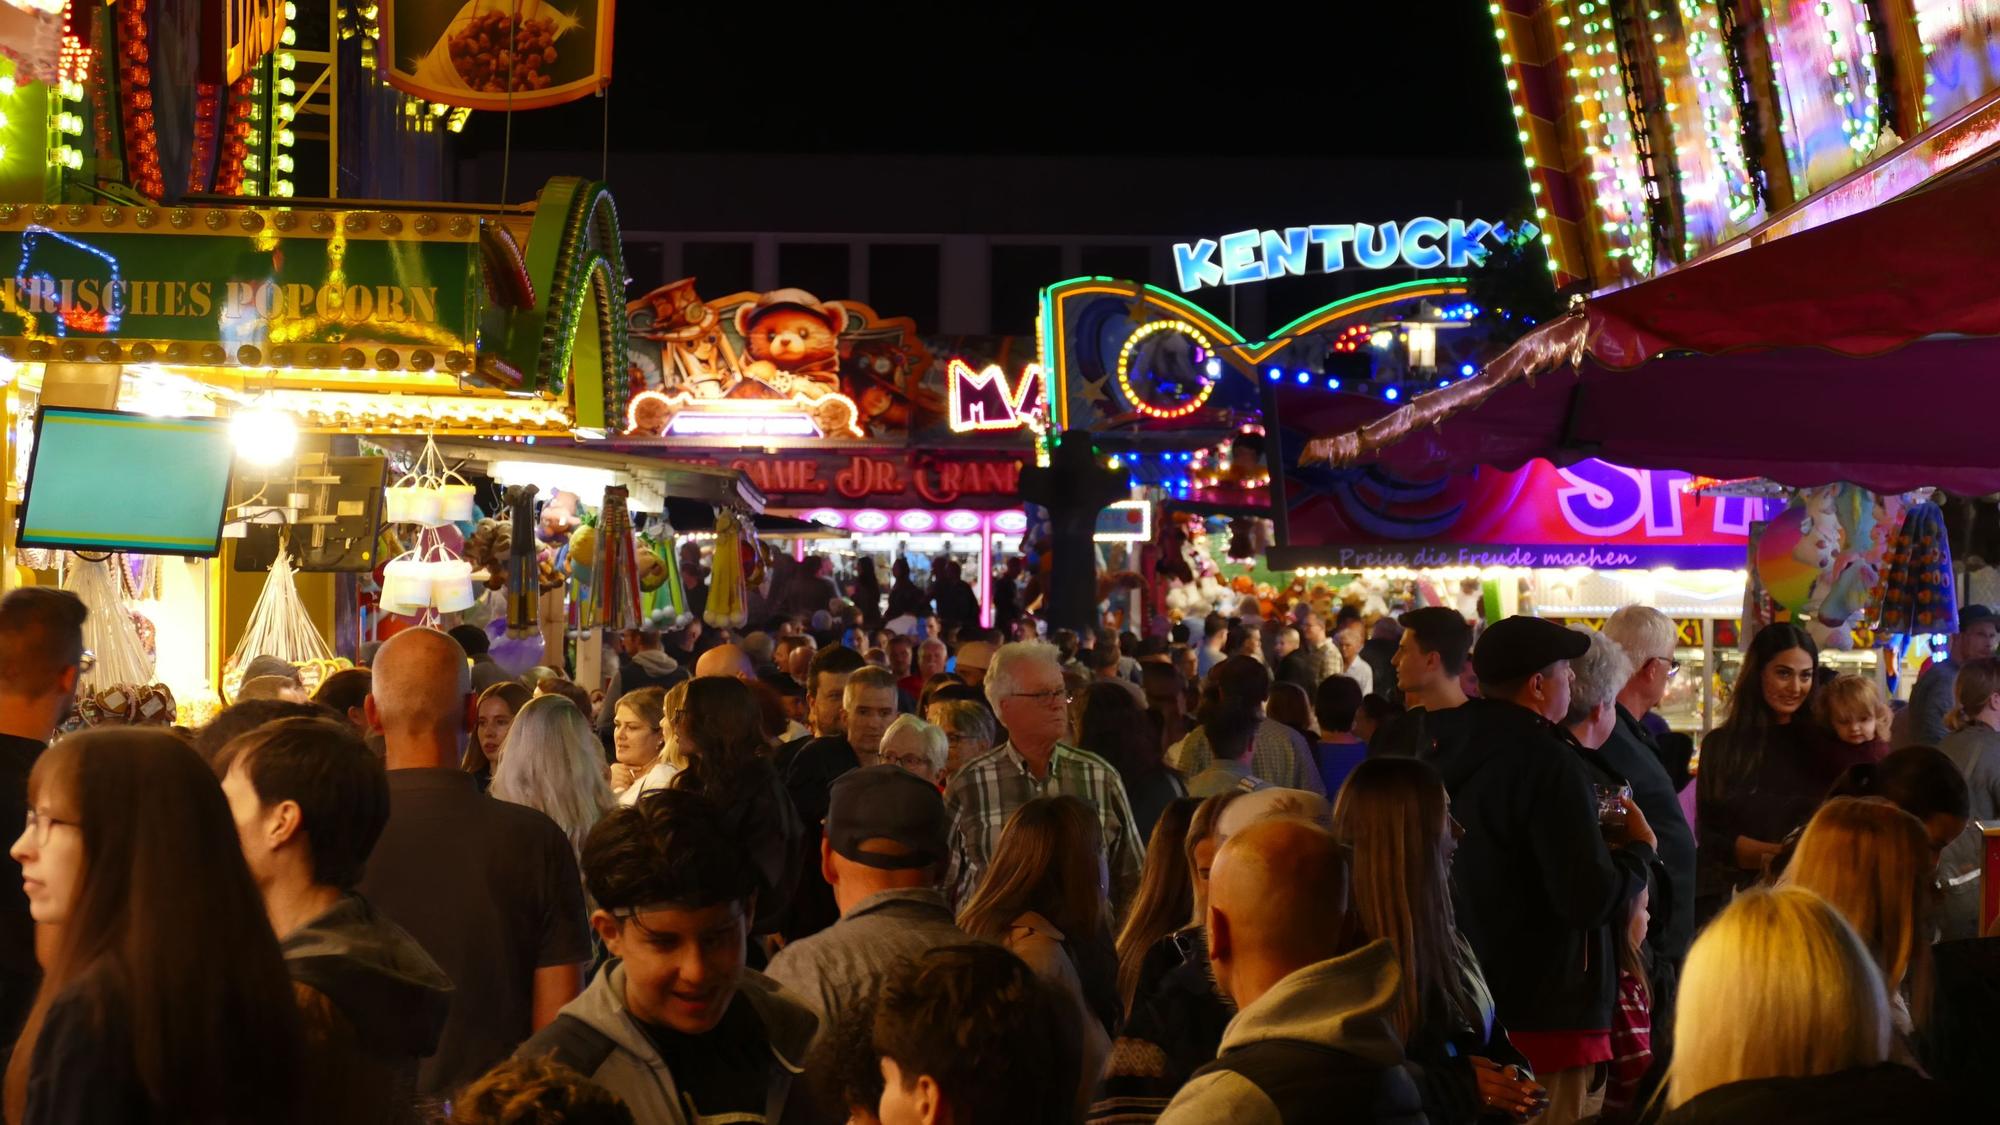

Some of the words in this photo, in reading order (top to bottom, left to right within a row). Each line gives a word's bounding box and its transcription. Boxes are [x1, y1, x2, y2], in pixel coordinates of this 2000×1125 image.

[2, 277, 212, 317] FRISCHES
[225, 281, 438, 323] POPCORN
[1339, 547, 1407, 566] Preise
[1413, 547, 1451, 566] die
[1457, 547, 1537, 566] Freude
[1542, 547, 1637, 567] machen
